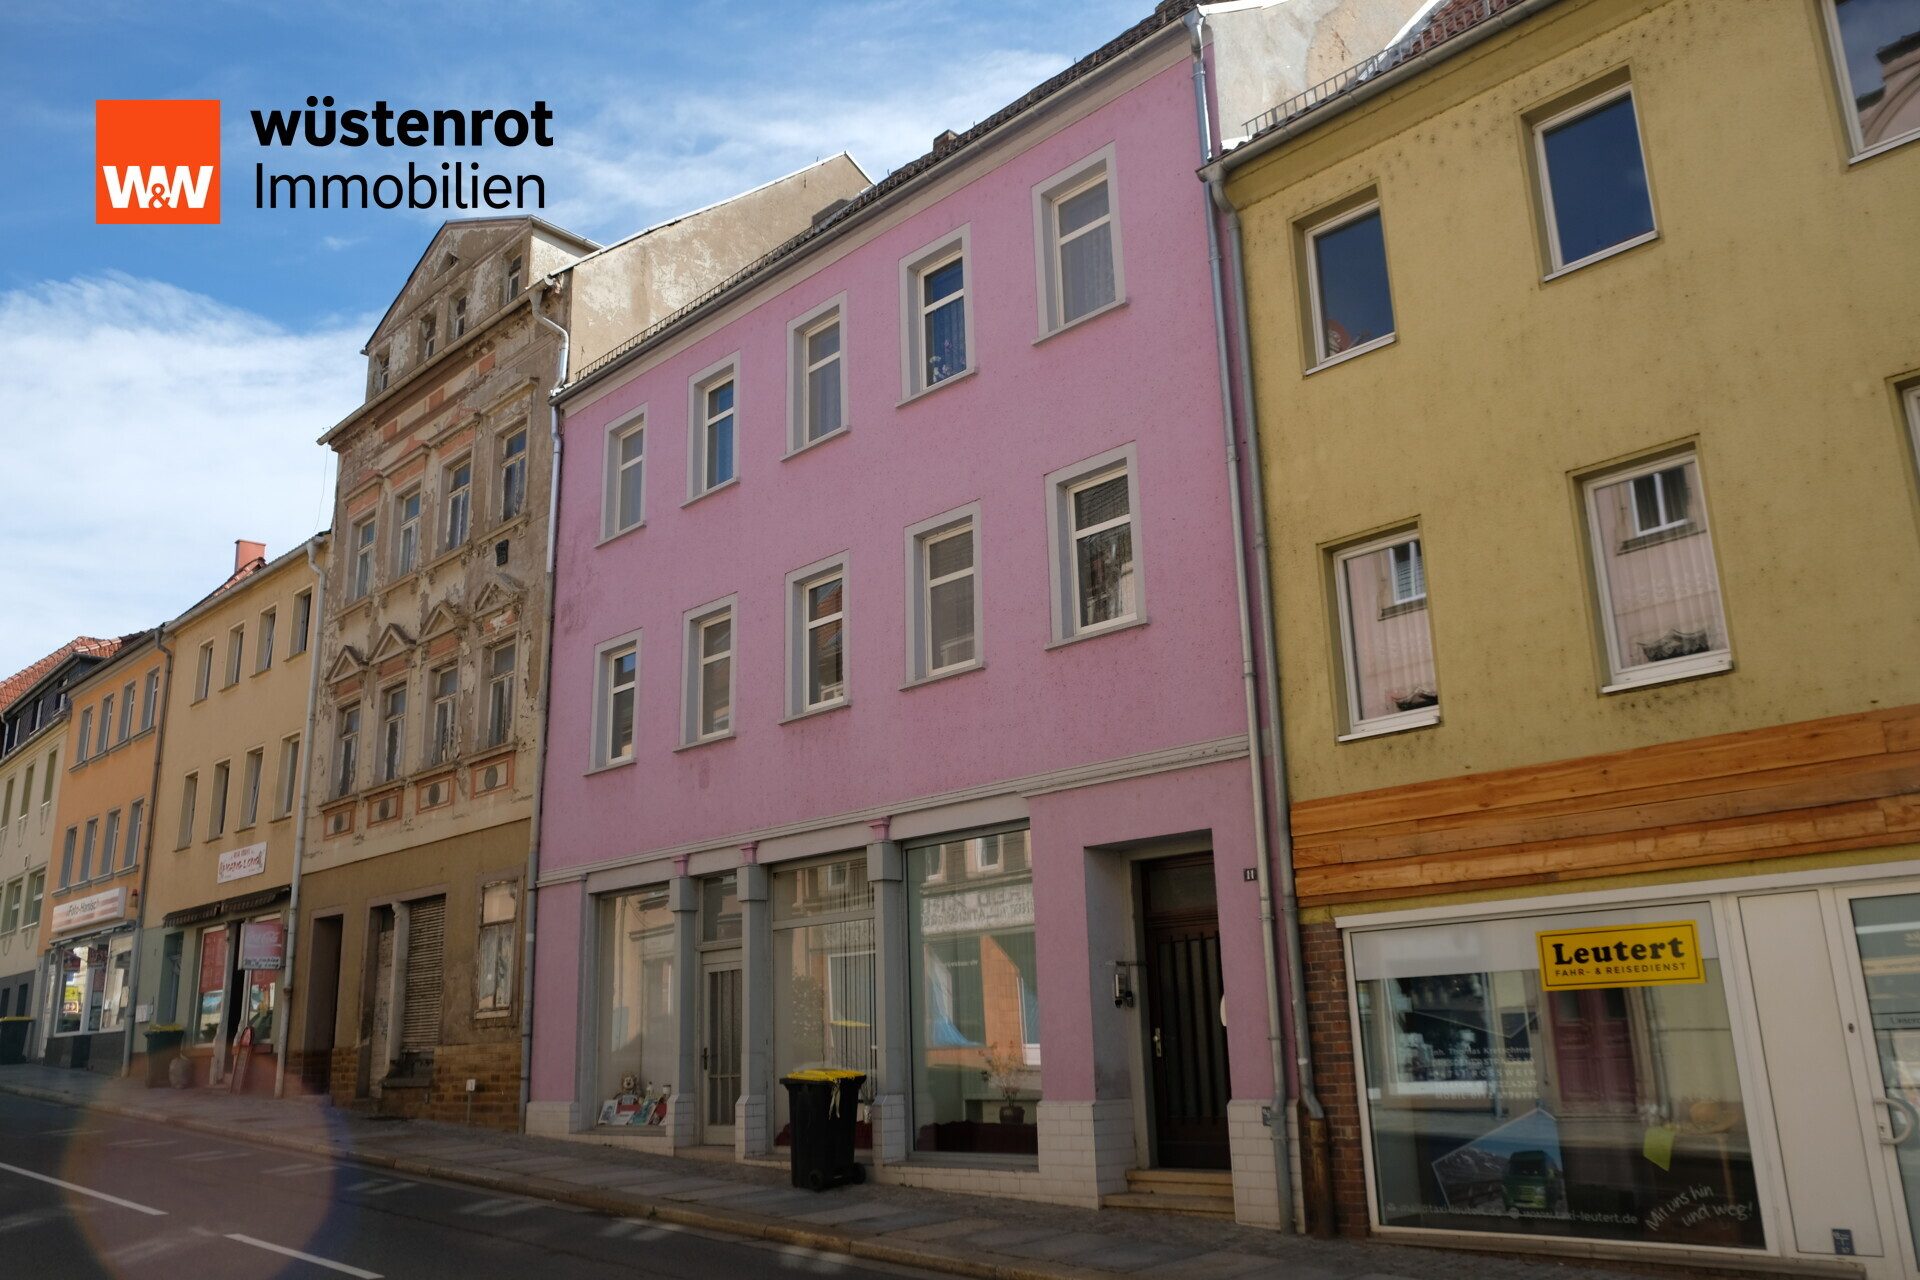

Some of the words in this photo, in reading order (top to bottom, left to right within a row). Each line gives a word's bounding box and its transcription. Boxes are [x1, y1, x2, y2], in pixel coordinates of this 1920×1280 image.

[1246, 869, 1254, 880] 11
[1552, 937, 1685, 965] Leutert
[1555, 968, 1591, 977] FAHR-
[1595, 967, 1601, 975] &
[1606, 962, 1686, 974] REISEDIENST
[1645, 1206, 1669, 1231] Mit
[1666, 1192, 1690, 1212] uns
[1689, 1184, 1714, 1200] hin
[1681, 1204, 1711, 1227] und
[1712, 1201, 1753, 1221] weg!
